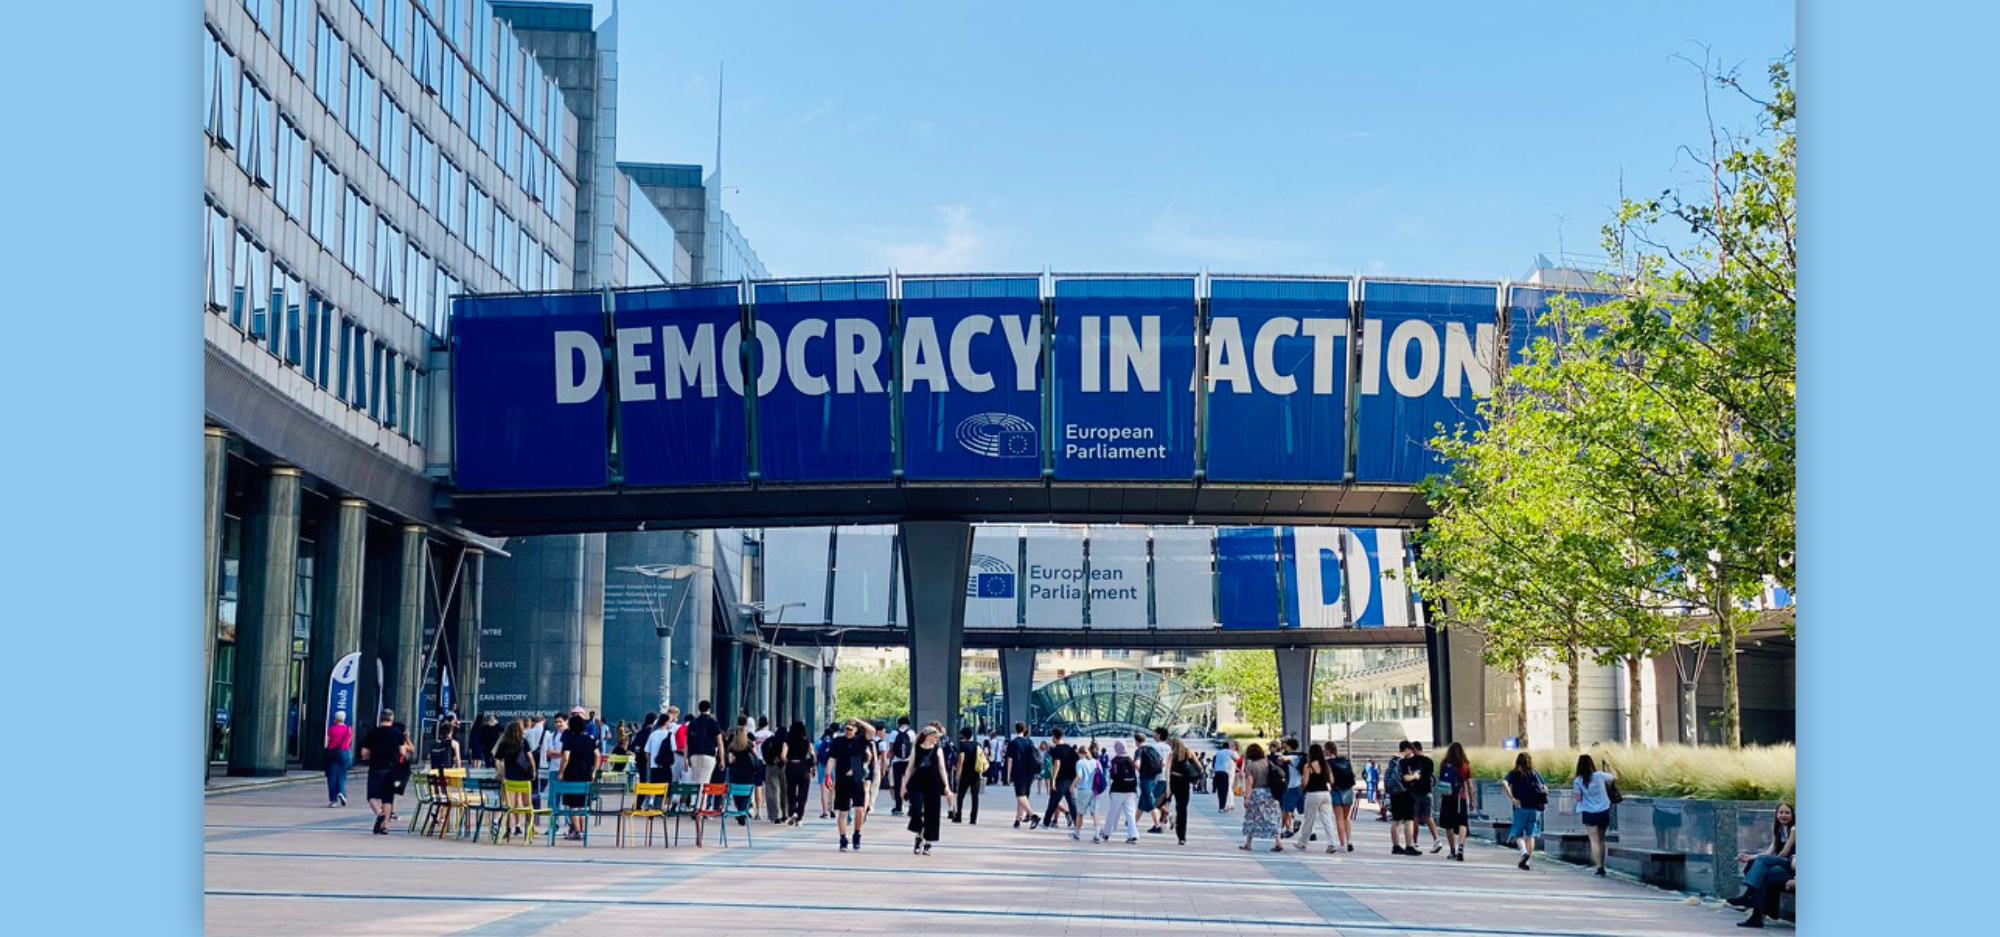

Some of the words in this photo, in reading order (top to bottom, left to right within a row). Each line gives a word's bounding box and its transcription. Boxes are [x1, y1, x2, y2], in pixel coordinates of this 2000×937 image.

[555, 314, 1059, 404] DEMOCRACY
[1081, 315, 1160, 393] IN
[1189, 315, 1499, 399] ACTION
[1066, 424, 1153, 443] European
[1066, 444, 1166, 459] Parliament
[1030, 565, 1123, 583] European
[1030, 584, 1137, 599] Parliament
[337, 689, 348, 709] Hub
